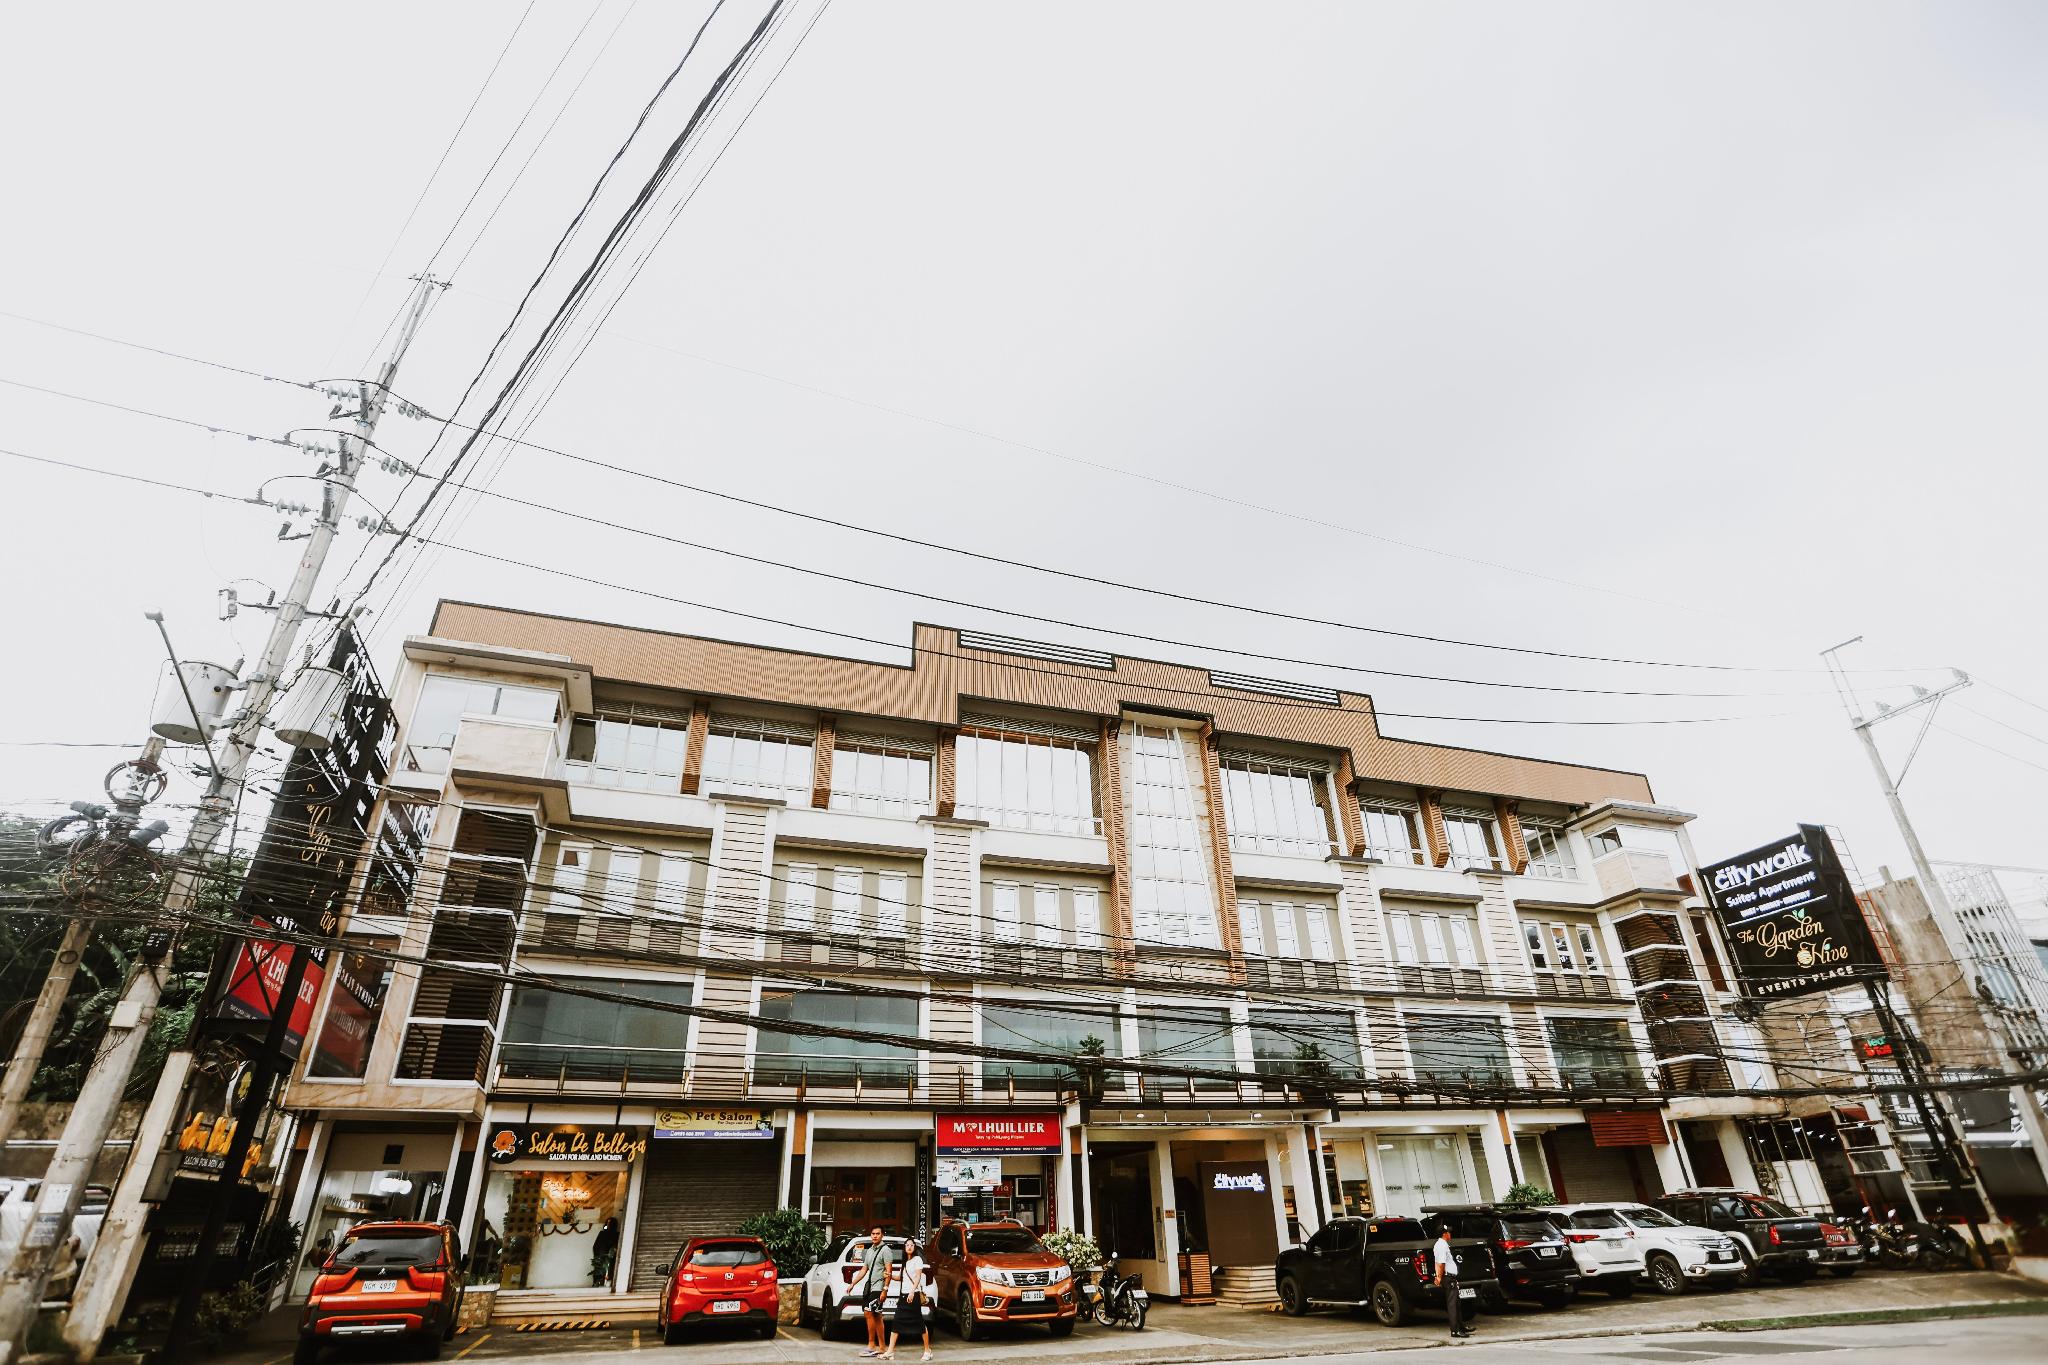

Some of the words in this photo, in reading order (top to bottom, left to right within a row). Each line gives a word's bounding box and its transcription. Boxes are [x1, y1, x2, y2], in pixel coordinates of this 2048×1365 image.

[1726, 892, 1757, 908] Suites
[1758, 871, 1816, 898] Apartment
[1736, 929, 1755, 944] The
[1800, 938, 1849, 966] Hive
[1758, 978, 1806, 995] EVENTS
[1812, 965, 1854, 982] PLACE
[695, 1111, 716, 1121] Pet
[719, 1111, 753, 1121] Salon
[978, 1123, 1045, 1133] LHUILLIER
[571, 1132, 588, 1153] De
[593, 1132, 646, 1162] Belleza
[183, 1155, 199, 1167] SALON
[603, 1154, 623, 1162] WOMEN
